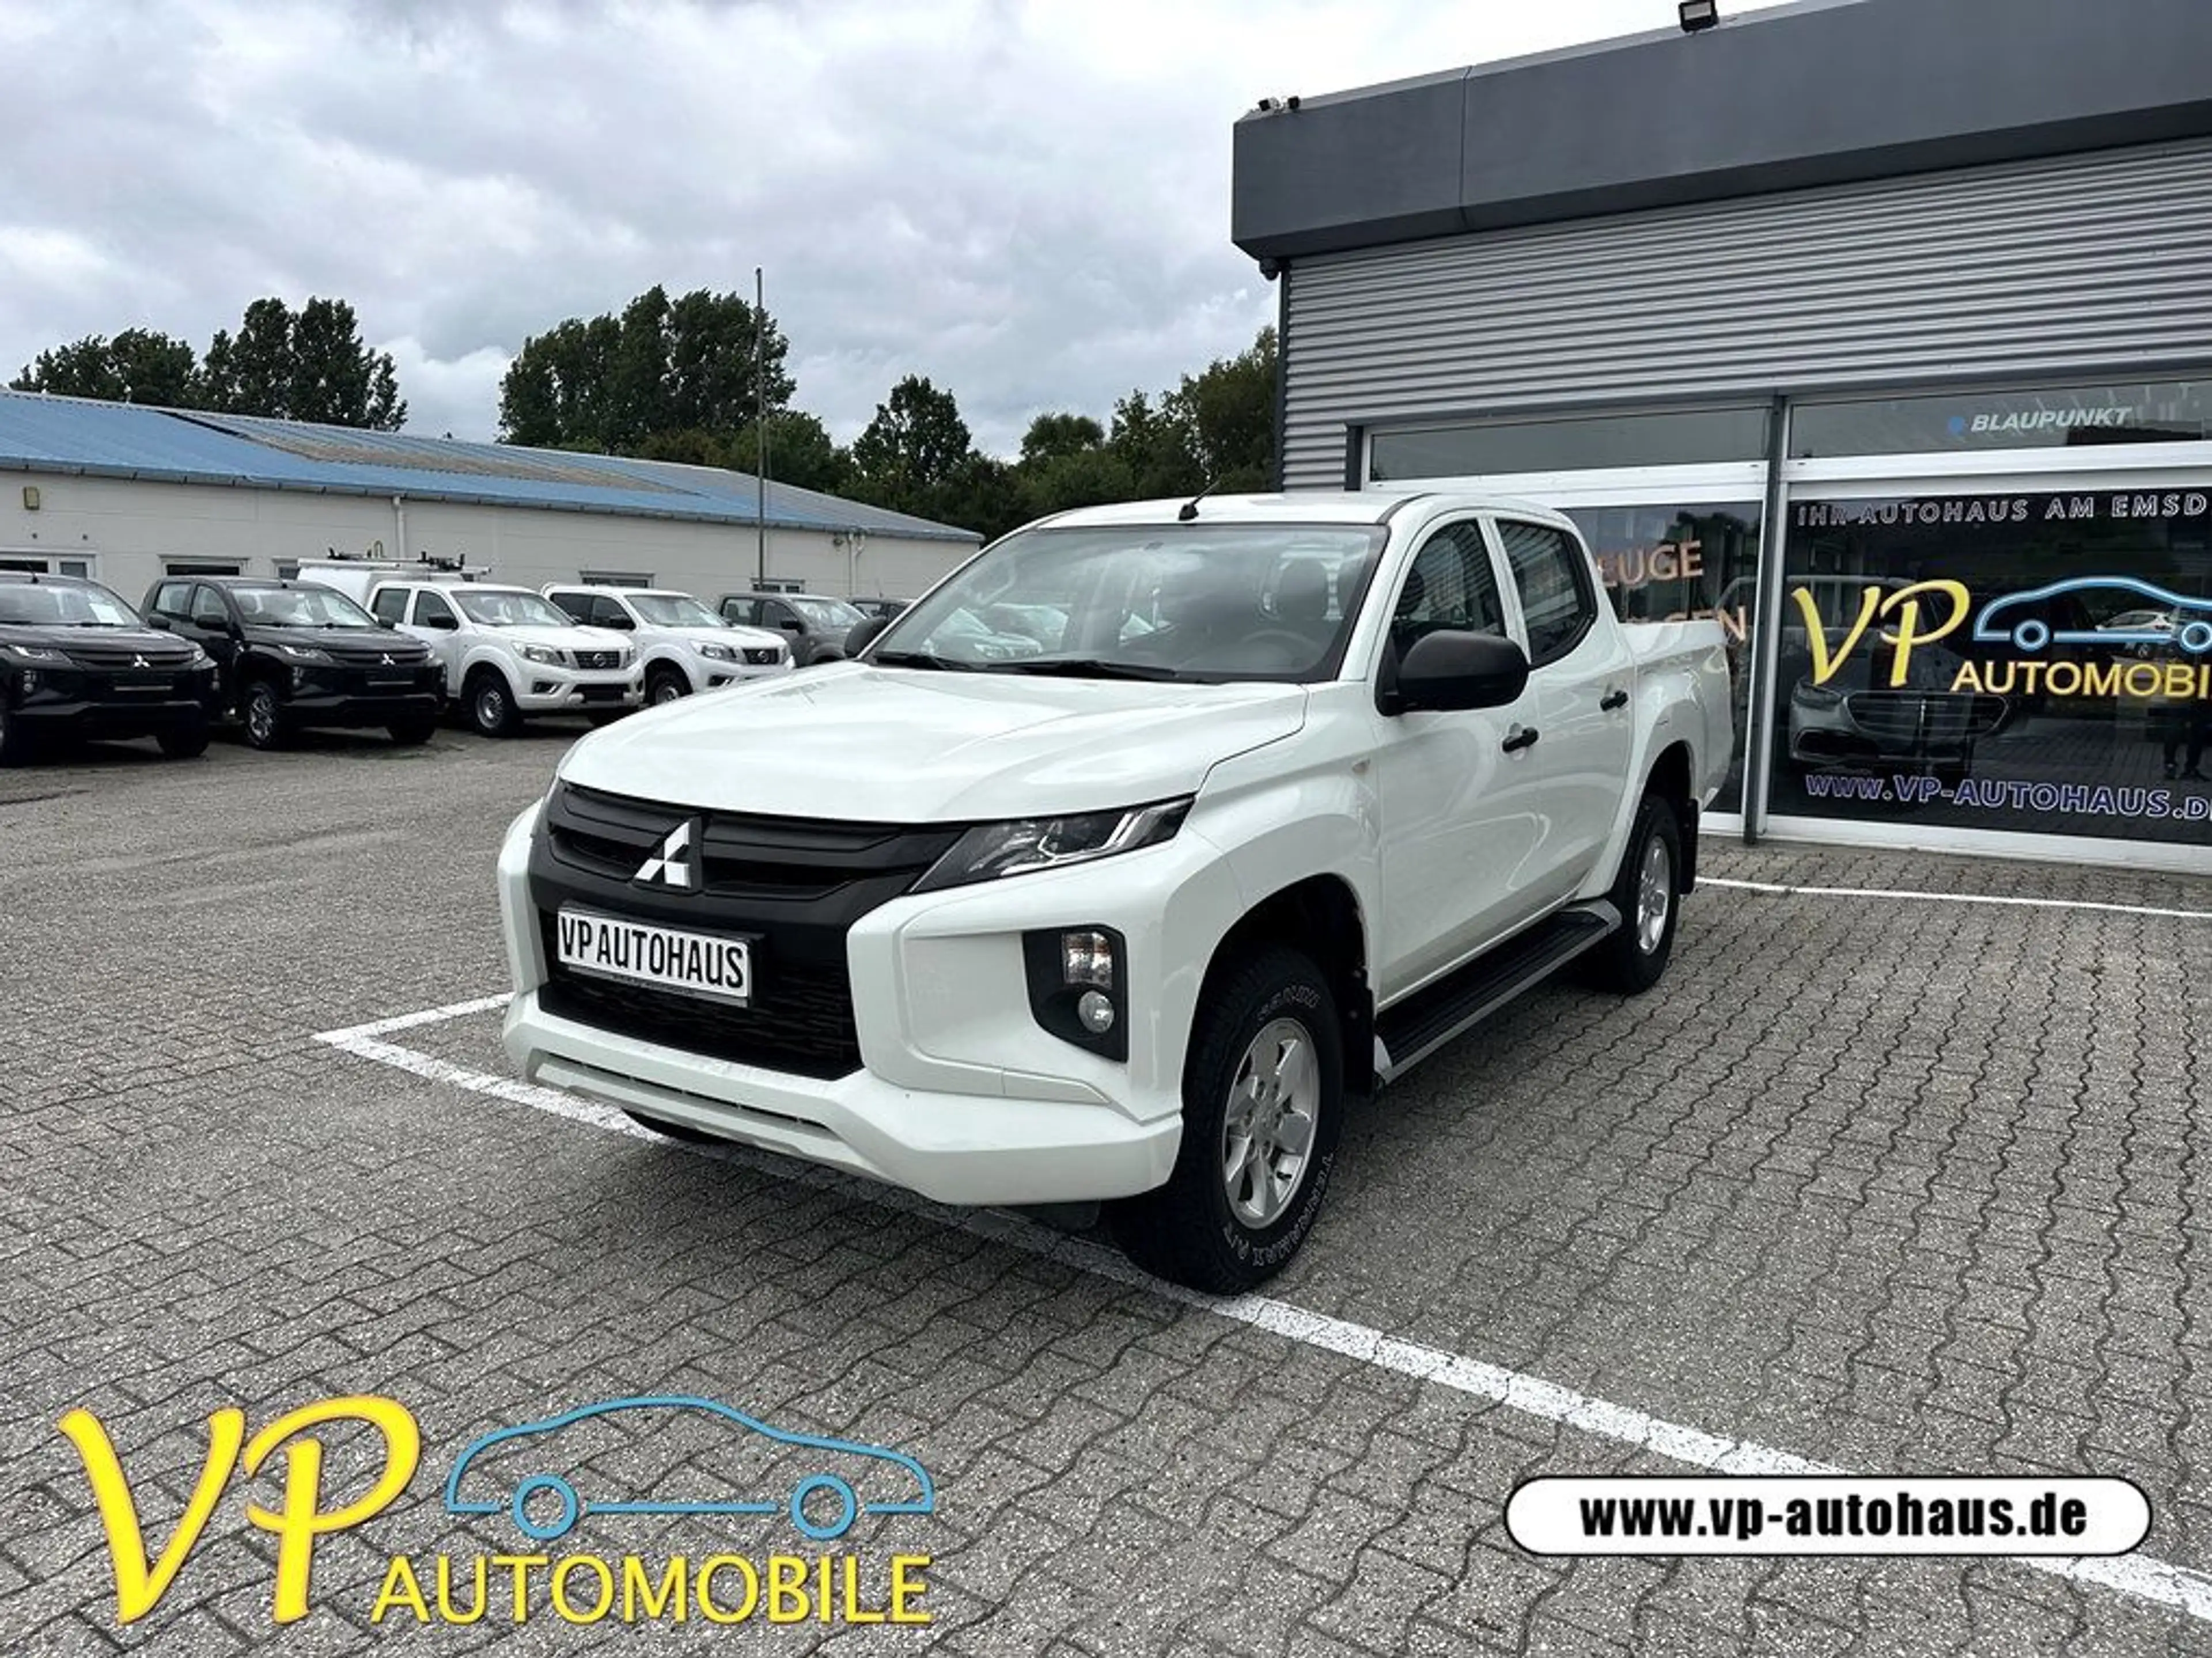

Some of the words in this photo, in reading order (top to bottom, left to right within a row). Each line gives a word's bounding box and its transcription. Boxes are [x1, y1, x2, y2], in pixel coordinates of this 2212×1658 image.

[1971, 407, 2133, 432] BLAUPUNKT
[1797, 504, 1846, 526] IHR
[1858, 499, 2029, 524] AUTOHAUS
[2045, 496, 2094, 519] AM
[1791, 579, 1971, 688] VP
[1949, 660, 2211, 699] AUTOMOBI
[561, 916, 592, 959] VP
[597, 924, 744, 988] AUTOHAUS
